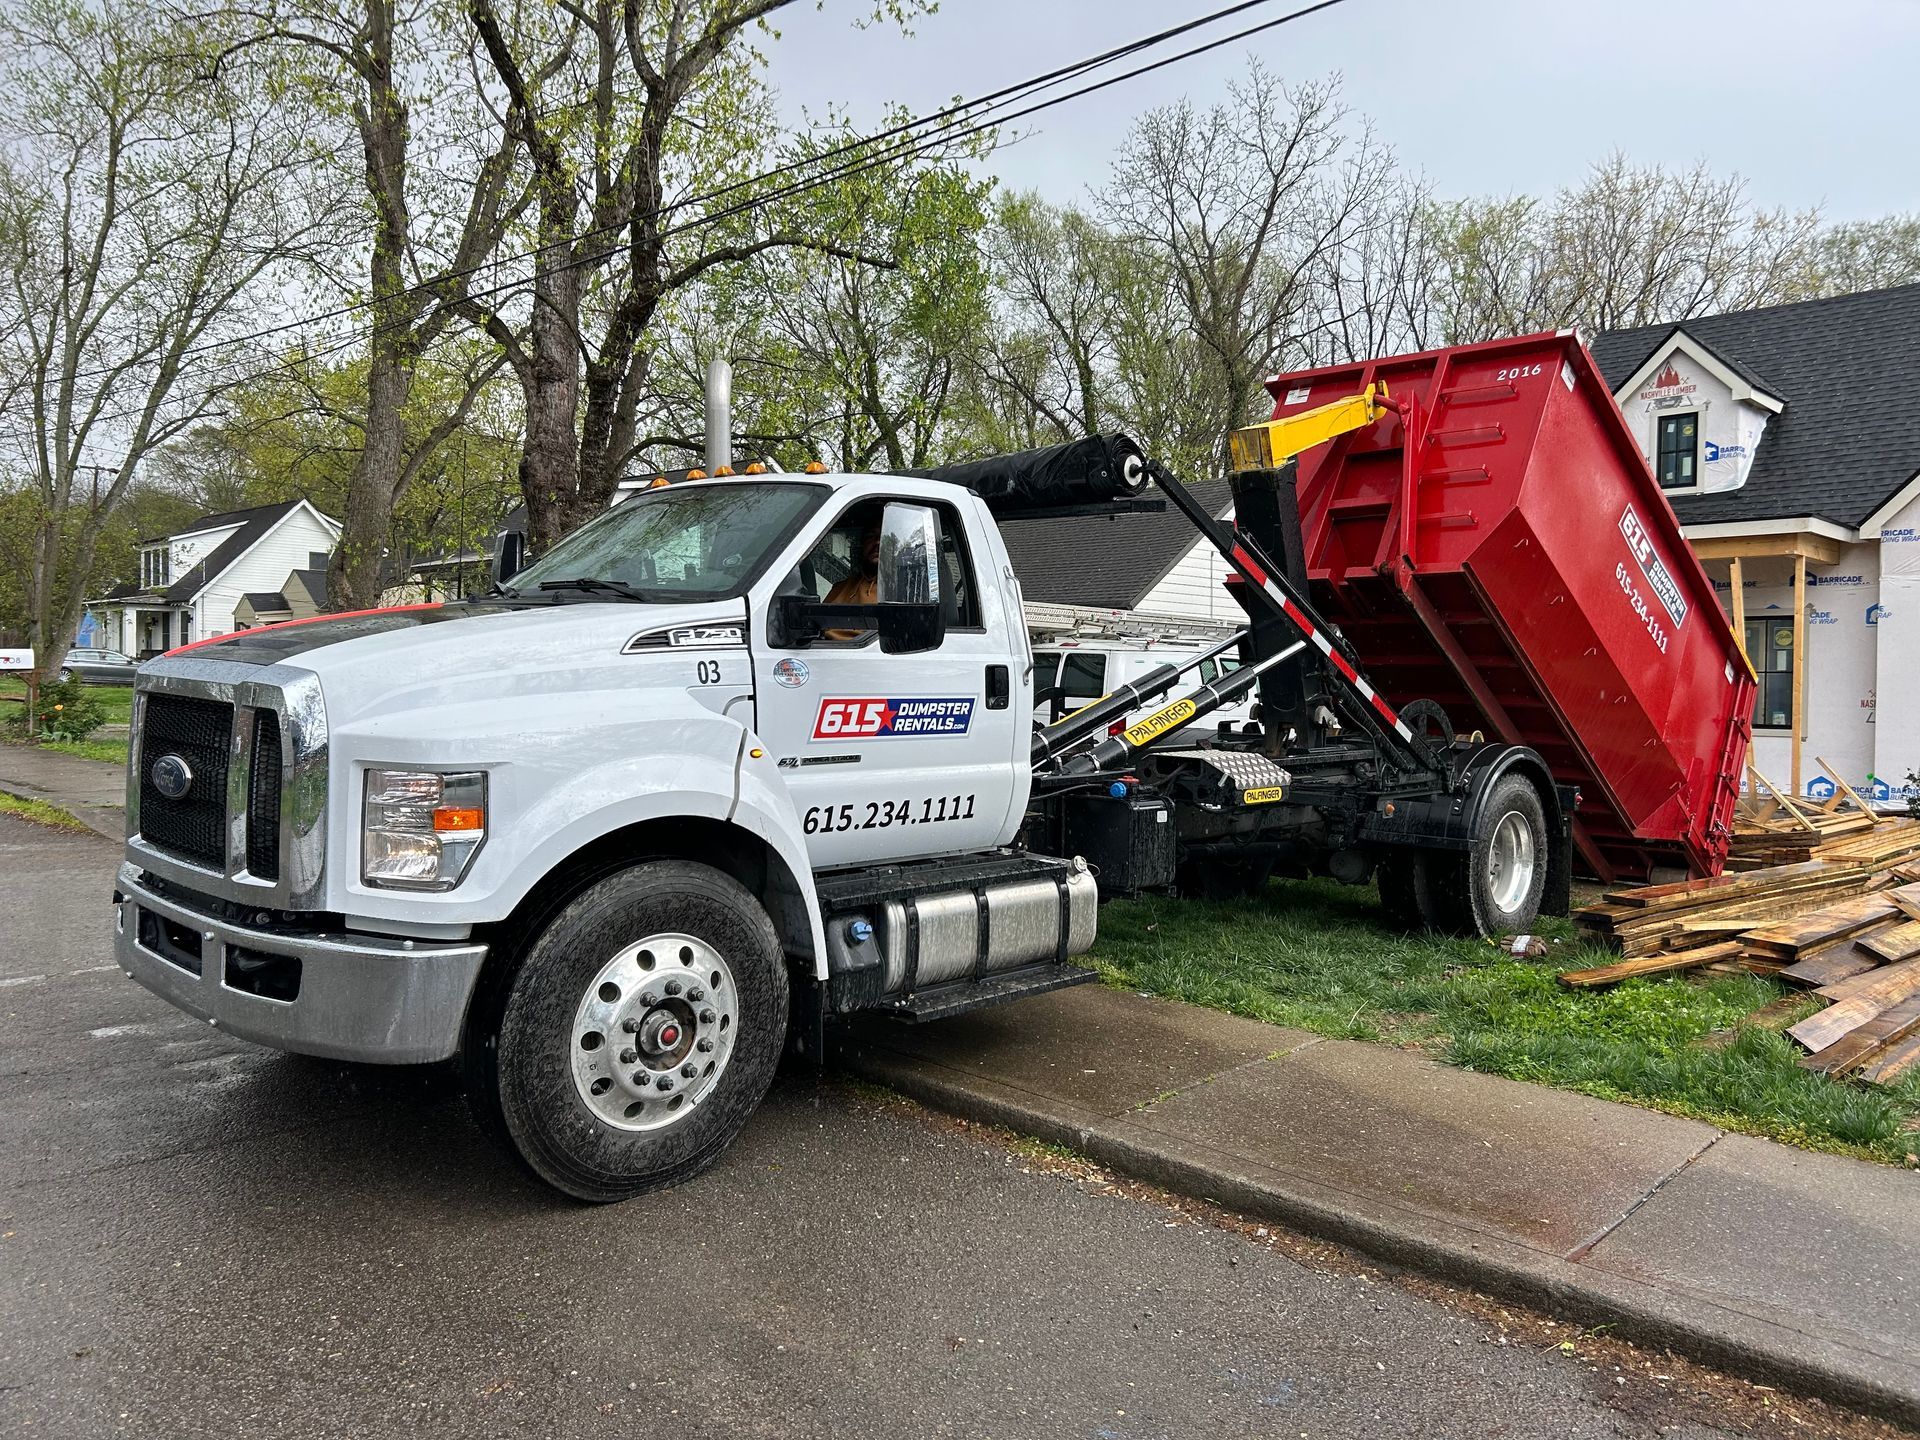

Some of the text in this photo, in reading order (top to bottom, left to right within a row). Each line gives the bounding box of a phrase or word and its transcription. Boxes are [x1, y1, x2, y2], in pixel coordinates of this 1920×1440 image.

[1496, 363, 1542, 381] 2016
[1640, 384, 1697, 400] NASHVILLE LUMBER
[1622, 511, 1652, 563] 615
[1652, 560, 1685, 615] DUMPSTER
[1818, 575, 1863, 584] BARRICADE
[1615, 562, 1668, 655] 615-234-1111
[1877, 611, 1893, 619] RAP
[697, 660, 721, 685] 03
[820, 703, 886, 734] 615
[897, 702, 970, 716] DUMPSTER
[1128, 701, 1193, 743] PALFINGER
[1246, 789, 1280, 801] PALFINGER
[803, 794, 976, 835] 615.234.1111
